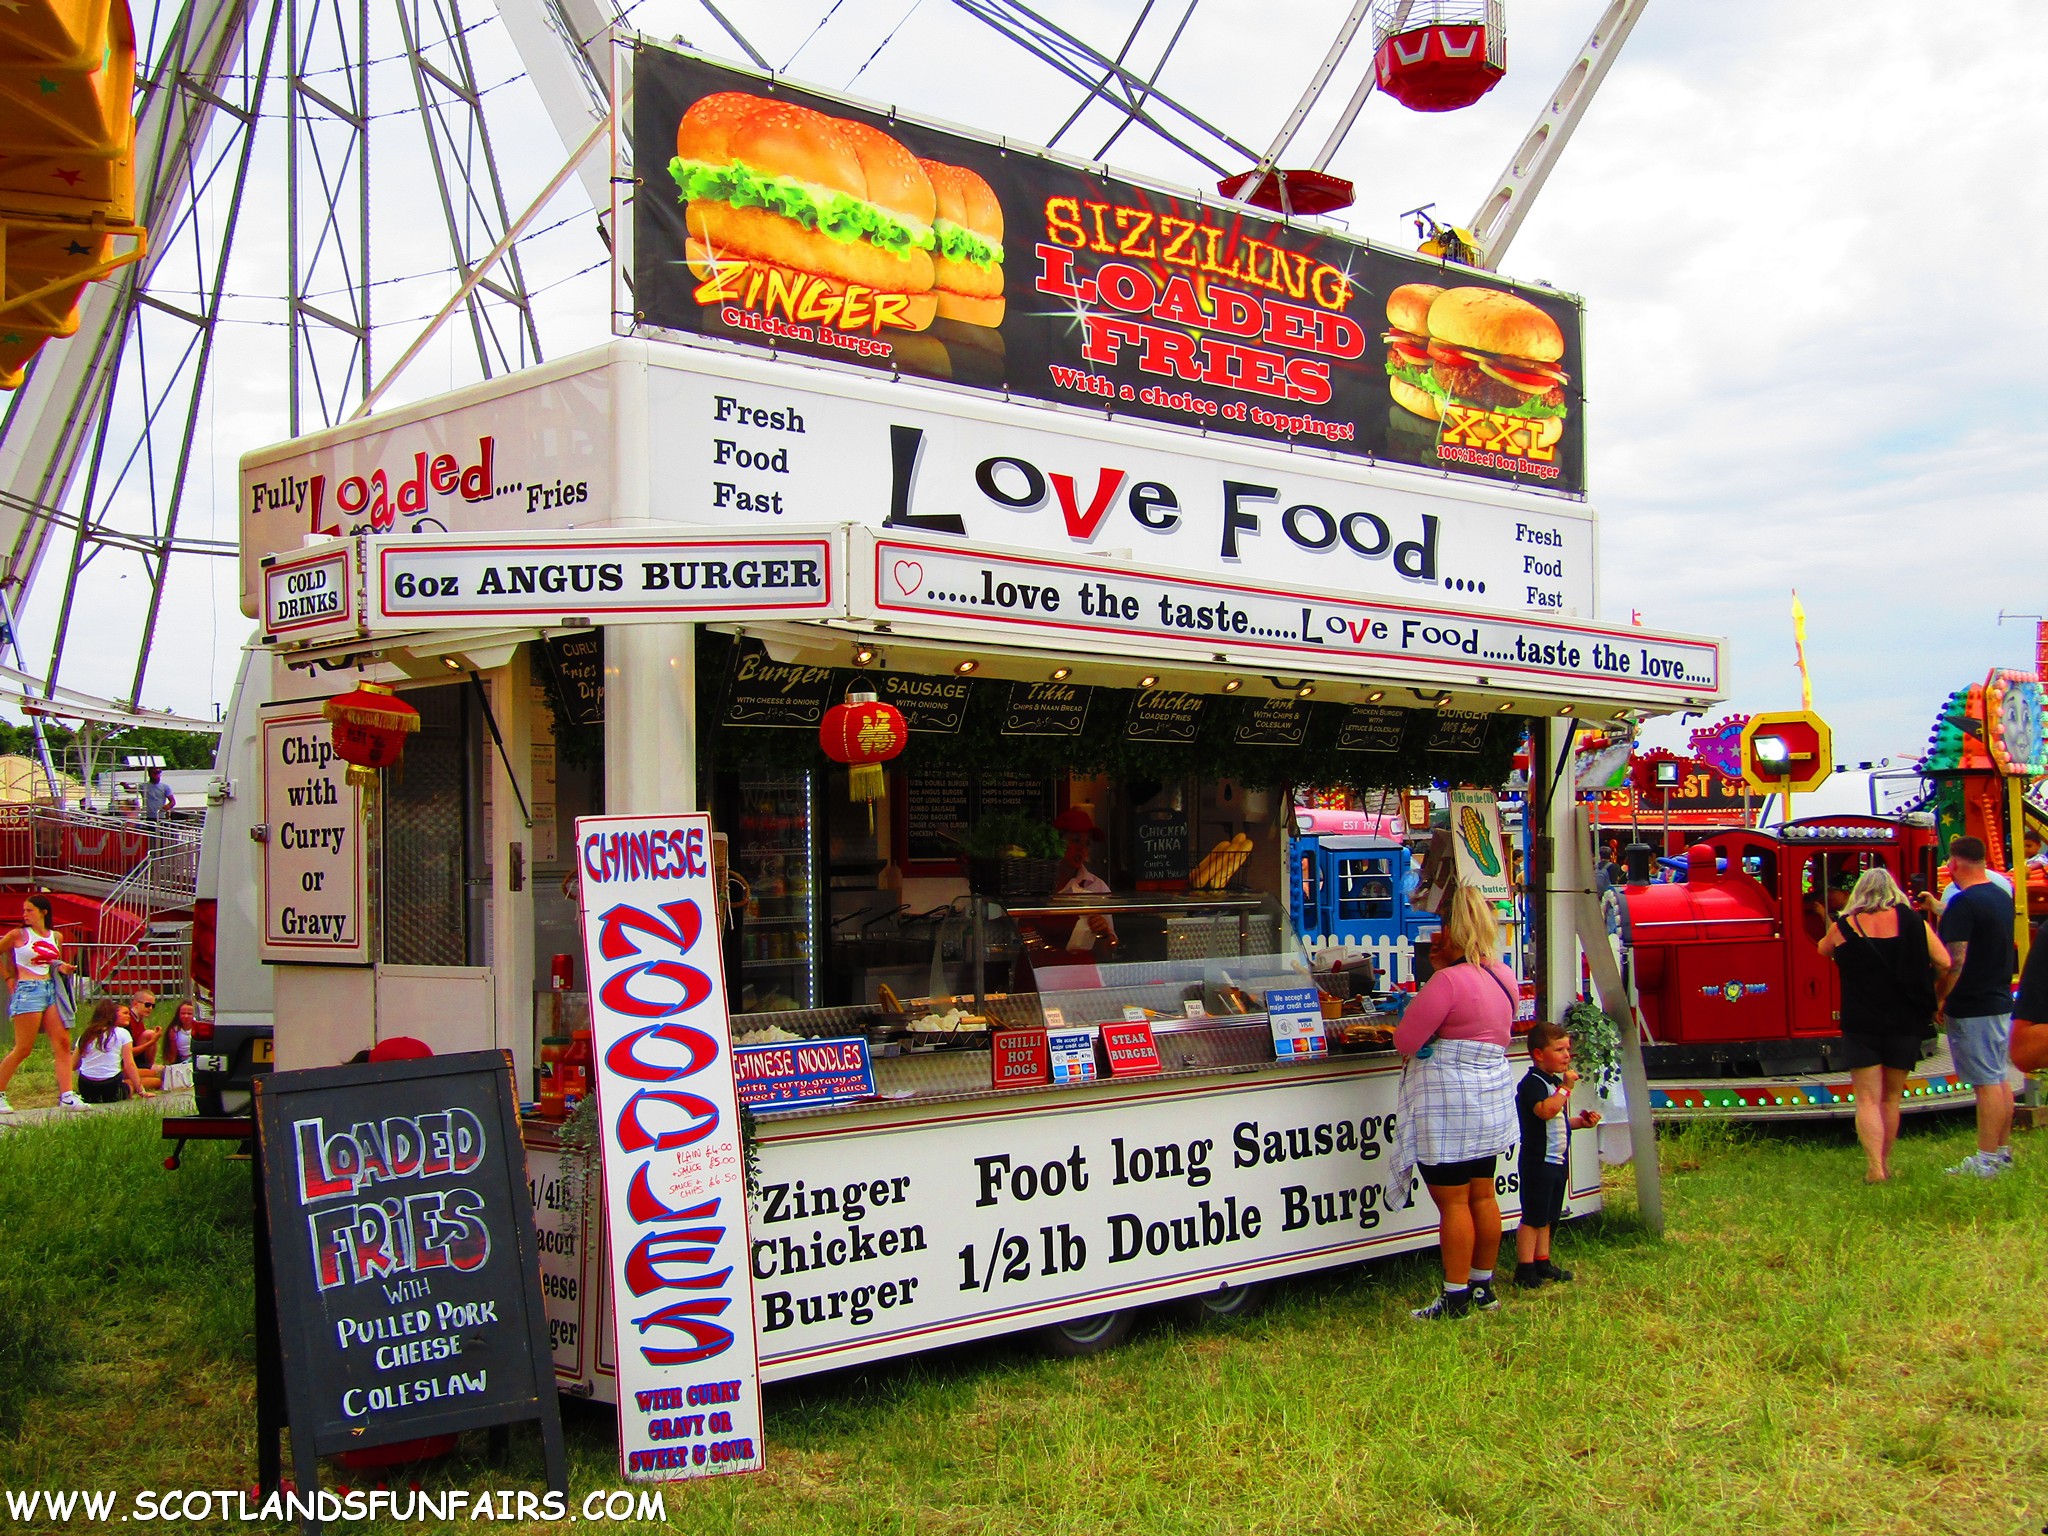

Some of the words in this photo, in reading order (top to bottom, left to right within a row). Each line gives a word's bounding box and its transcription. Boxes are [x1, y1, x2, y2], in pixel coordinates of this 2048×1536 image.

[1045, 195, 1354, 311] SIZZLING
[693, 259, 916, 336] ZINGER
[1035, 242, 1366, 361] LOADED
[722, 306, 815, 345] Chicken
[817, 327, 892, 357] Burger
[1081, 316, 1333, 406] FRIES
[713, 395, 806, 435] Fresh
[1050, 364, 1115, 397] With
[1120, 382, 1135, 401] a
[1139, 382, 1217, 417] choice
[1221, 397, 1247, 422] of
[1251, 405, 1355, 442] toppings!
[1442, 403, 1556, 461] XXL
[713, 439, 789, 474] Food
[1496, 455, 1516, 472] 8oz
[1518, 458, 1560, 479] Burger
[252, 476, 308, 514] Fully
[526, 479, 588, 513] Fries
[713, 481, 783, 515] Fast
[890, 424, 1182, 544] Love
[1515, 523, 1563, 548] Fresh
[286, 568, 327, 594] COLD
[394, 572, 459, 598] 6oz
[477, 562, 623, 595] ANGUS
[642, 559, 821, 591] BURGER
[1523, 555, 1563, 578] Food
[277, 591, 338, 620] DRINKS
[1526, 587, 1563, 608] Fast
[1079, 582, 1139, 620] the
[1592, 643, 1631, 675] the
[562, 641, 599, 658] CURLY
[737, 653, 831, 694] Burger
[886, 676, 966, 699] SAUSAGE
[737, 695, 755, 704] WITH
[756, 697, 785, 705] CHEESE
[785, 697, 793, 705] &
[793, 698, 820, 706] ONIONS
[895, 699, 916, 708] WITH
[917, 701, 949, 711] ONIONS
[1027, 682, 1076, 702] Tikka
[1033, 703, 1040, 711] &
[1137, 690, 1203, 712] Chicken
[1436, 709, 1490, 721] BURGER
[288, 778, 338, 806] with
[281, 822, 345, 855] Curry
[1139, 821, 1188, 839] CHICKEN
[1343, 821, 1358, 830] EST
[584, 827, 708, 884] CHINESE
[1143, 838, 1181, 852] TIKKA
[302, 870, 325, 892] or
[281, 907, 346, 942] Gravy
[1000, 1035, 1041, 1050] CHILLI
[1112, 1033, 1147, 1046] STEAK
[1112, 1047, 1156, 1061] BURGER
[733, 1049, 794, 1080] CHINESE
[798, 1044, 863, 1075] NOODLES
[1004, 1062, 1038, 1076] DOGS
[1007, 1050, 1035, 1063] HOT
[738, 1091, 776, 1104] weet
[799, 1086, 828, 1098] sour
[833, 1083, 867, 1094] sauce
[598, 896, 736, 1367] NOODLES
[294, 1107, 486, 1205] LOADED
[676, 1149, 701, 1165] PLAIN
[974, 1144, 1089, 1208] Foot
[1112, 1134, 1214, 1188] long
[1233, 1112, 1397, 1170] Sausage
[669, 1180, 692, 1195] SAUCE
[680, 1186, 704, 1199] CHIPS
[762, 1175, 911, 1225] Zinger
[537, 1229, 575, 1257] acon
[1108, 1194, 1262, 1263] Double
[753, 1222, 928, 1280] Chicken
[543, 1273, 577, 1301] eese
[761, 1275, 919, 1333] Burger
[337, 1309, 431, 1349] PULLED
[437, 1300, 499, 1331] PORK
[551, 1318, 577, 1350] ger
[376, 1334, 462, 1370] CHEESE
[343, 1369, 487, 1417] COLESLAW
[635, 1387, 683, 1412] WITH
[686, 1379, 742, 1407] CURRY
[648, 1414, 705, 1441] GRAVY
[708, 1411, 733, 1434] OR
[629, 1446, 688, 1473] SWEET
[710, 1438, 755, 1463] SOUR
